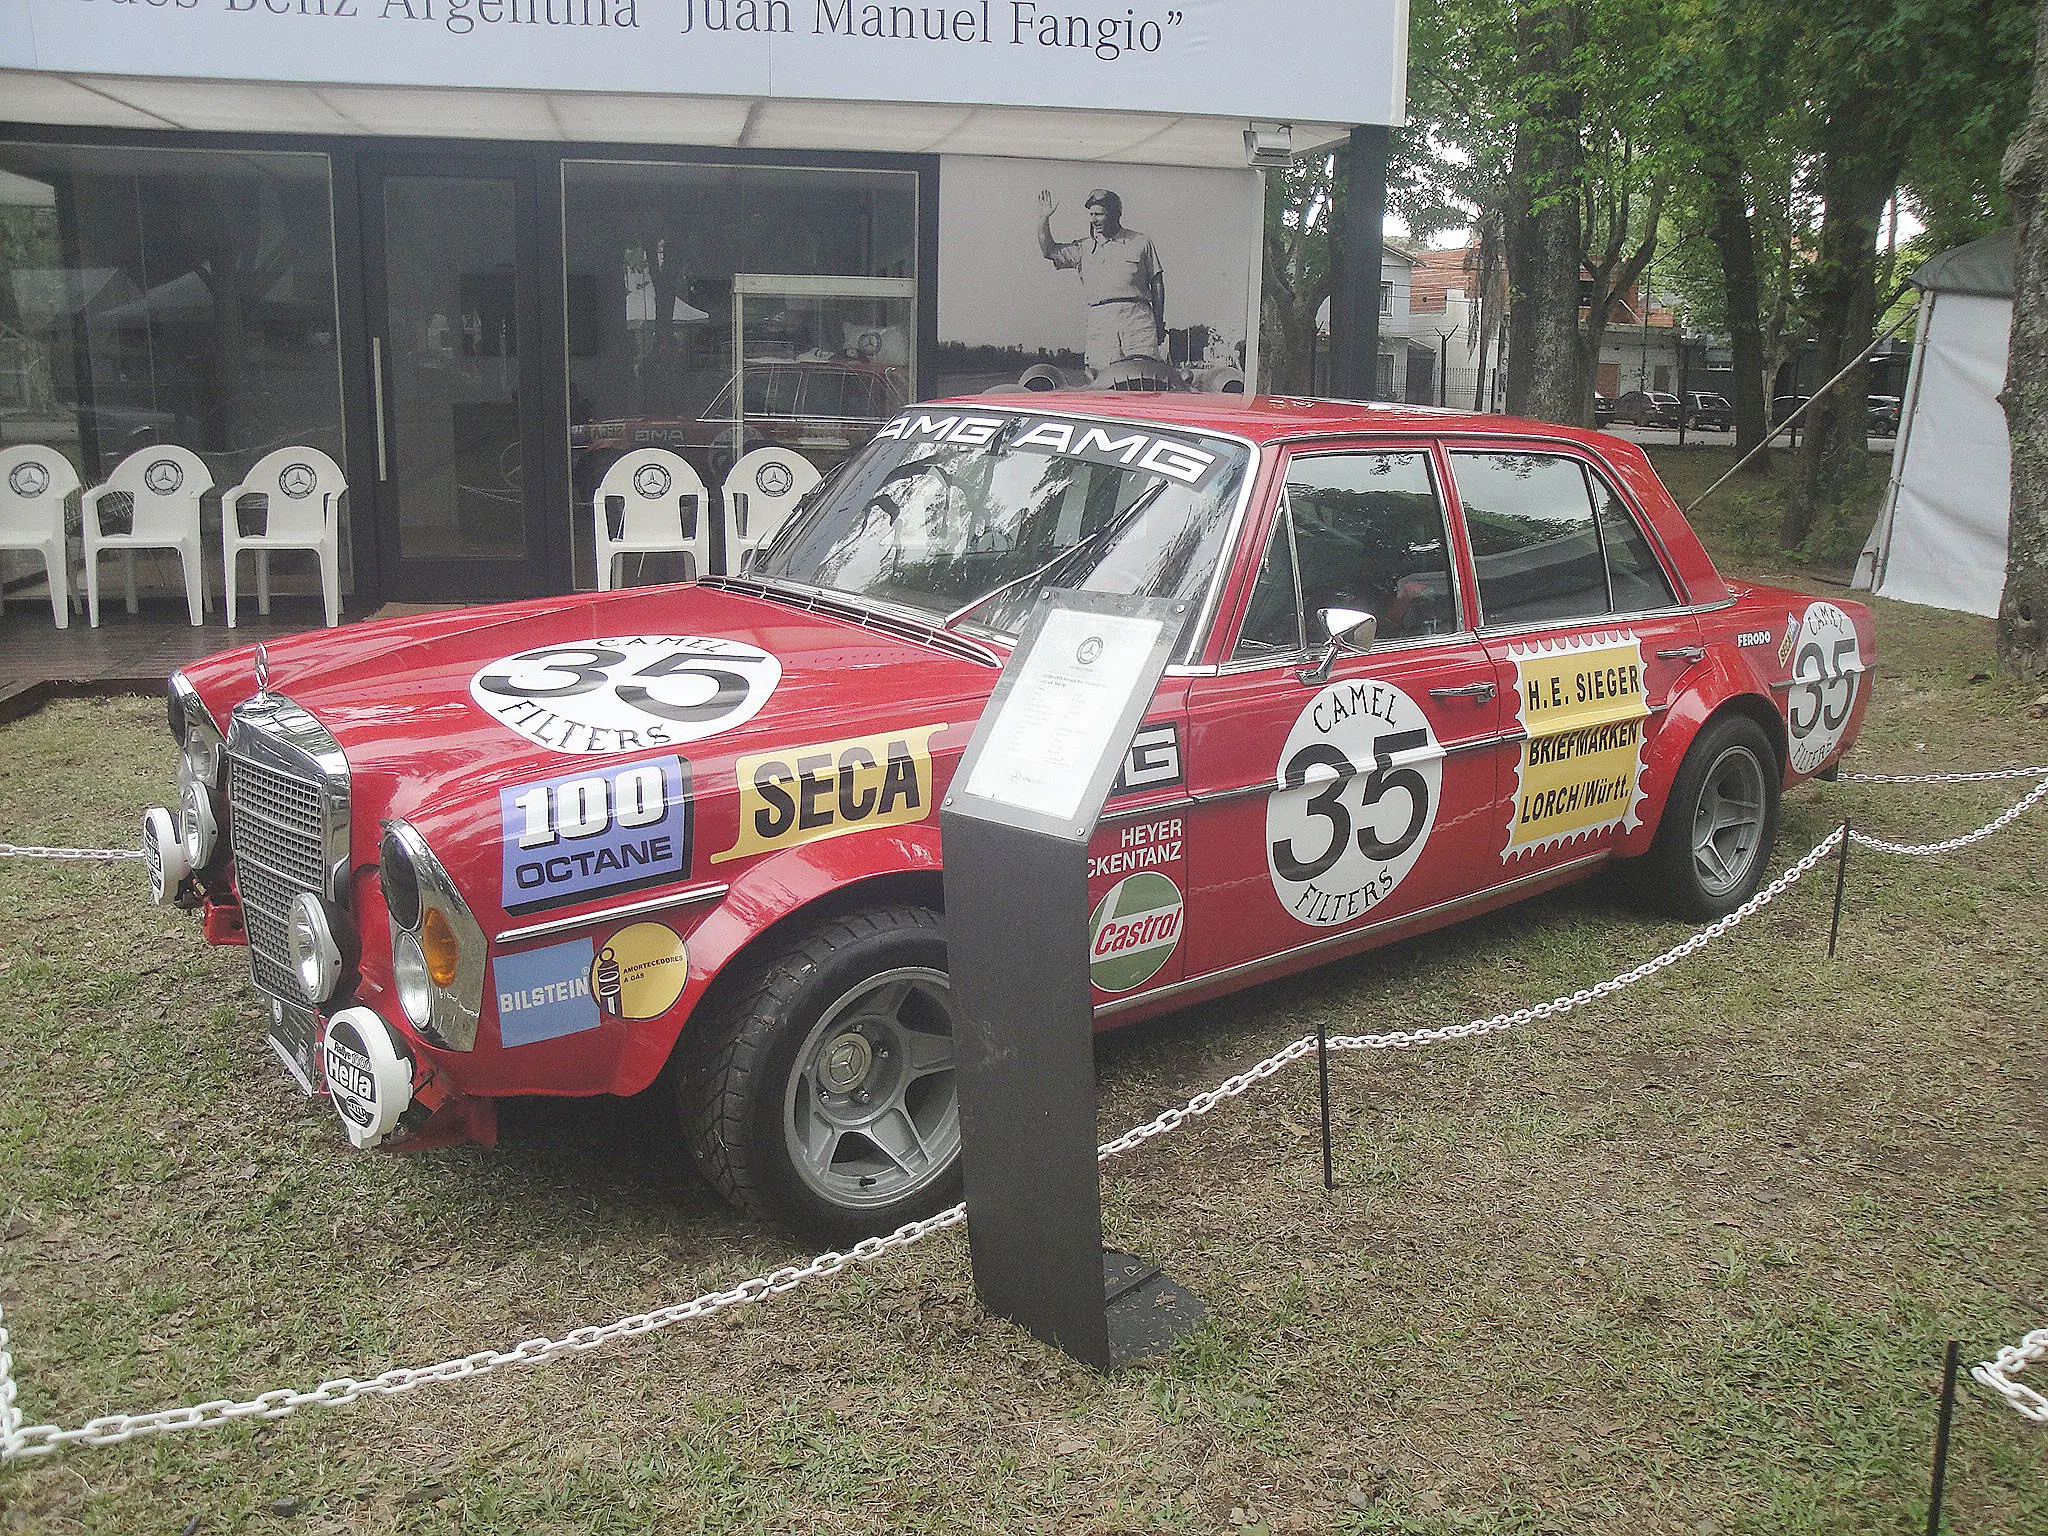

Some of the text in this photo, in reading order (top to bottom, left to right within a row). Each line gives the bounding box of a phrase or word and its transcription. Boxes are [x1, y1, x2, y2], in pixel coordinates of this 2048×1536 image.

[680, 0, 793, 33] Juan
[811, 0, 992, 44] Manuel
[866, 415, 1216, 484] AMG AMG
[595, 637, 730, 652] CAMEL
[1737, 631, 1771, 648] FERODO
[1807, 605, 1844, 636] CAMEL
[479, 648, 766, 722] 35
[1576, 665, 1640, 702] SIEGER
[1790, 638, 1856, 739] 35
[498, 700, 672, 752] FILTERS
[1313, 684, 1397, 734] CAMEL
[1528, 719, 1640, 766] BRIEFMARKEN
[515, 766, 667, 850] 100
[754, 740, 921, 838] SECA
[1272, 728, 1429, 882] 35
[1521, 773, 1629, 824] LORCH/Württ.
[1121, 818, 1182, 848] HEYER
[515, 836, 673, 889] OCTANE
[1087, 840, 1182, 878] CKENTANZ
[1294, 865, 1394, 924] FILTERS
[1095, 906, 1183, 956] Castrol
[623, 955, 683, 974] AMORTECEDORES
[499, 976, 590, 1013] BILSTEIN
[329, 1052, 373, 1100] Hella
